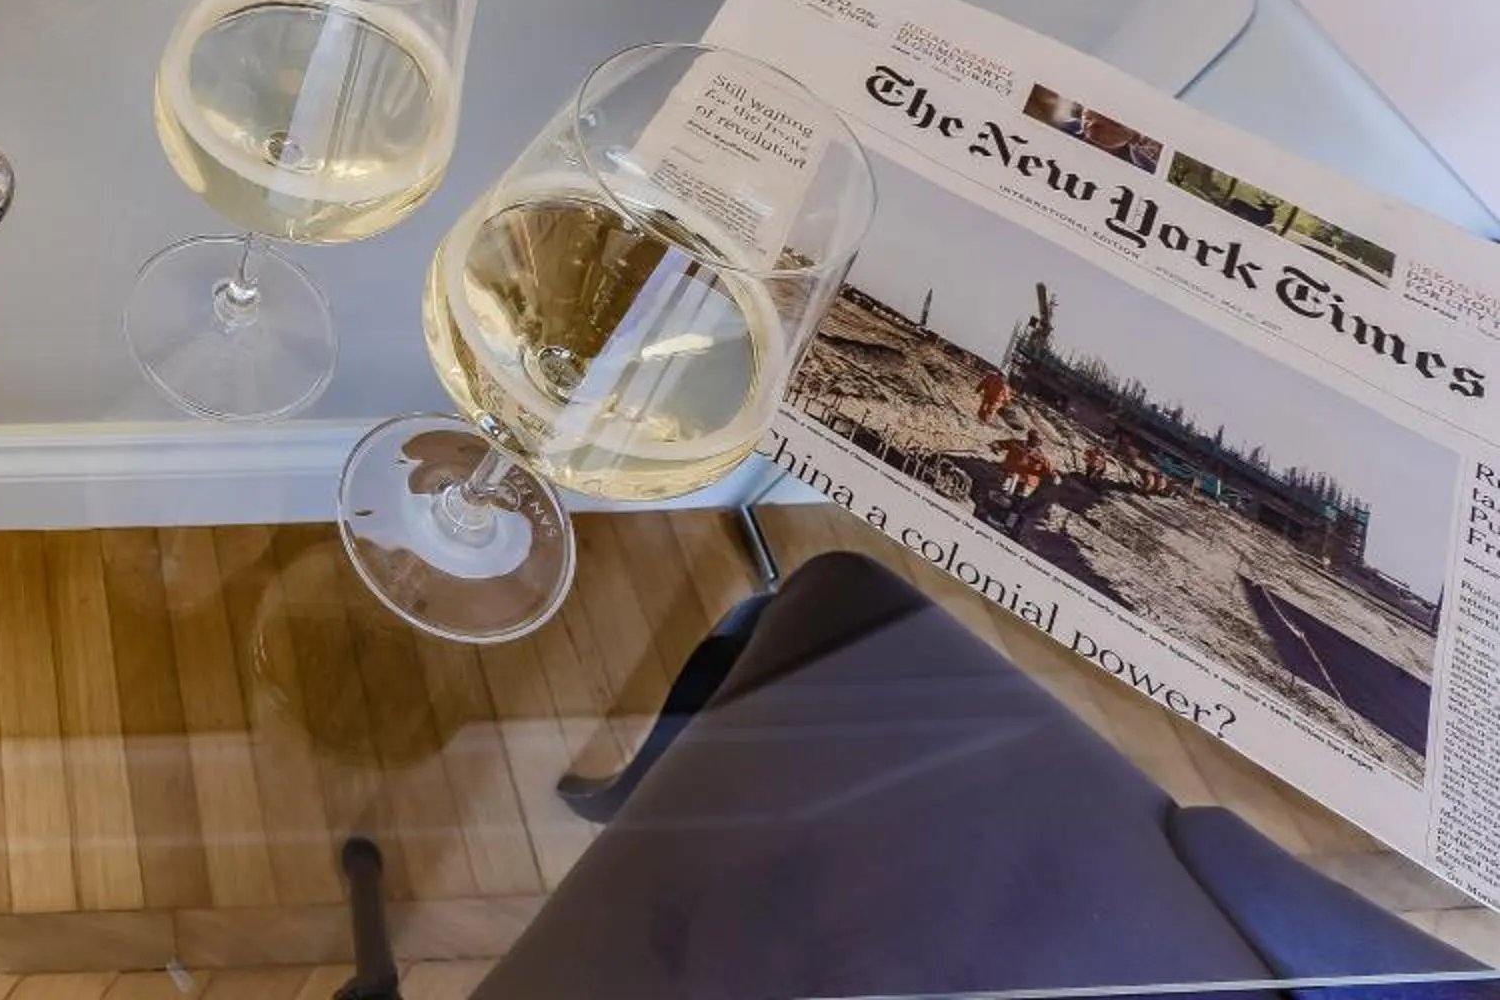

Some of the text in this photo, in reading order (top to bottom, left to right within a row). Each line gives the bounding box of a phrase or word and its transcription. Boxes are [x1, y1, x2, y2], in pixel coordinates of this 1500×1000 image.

[695, 105, 715, 120] of
[717, 115, 808, 169] revolution
[712, 73, 814, 138] Still waiting
[734, 105, 761, 125] the
[865, 64, 966, 138] The
[969, 121, 1100, 202] New
[1105, 185, 1263, 289] York
[1275, 265, 1486, 399] Times
[999, 184, 1140, 260] INTERNATIONAL EDITION
[1473, 487, 1500, 513] ta
[1476, 462, 1500, 488] R
[1467, 527, 1500, 558] Fr
[866, 506, 889, 530] a
[901, 527, 1058, 633] colonial
[1070, 630, 1237, 739] power?
